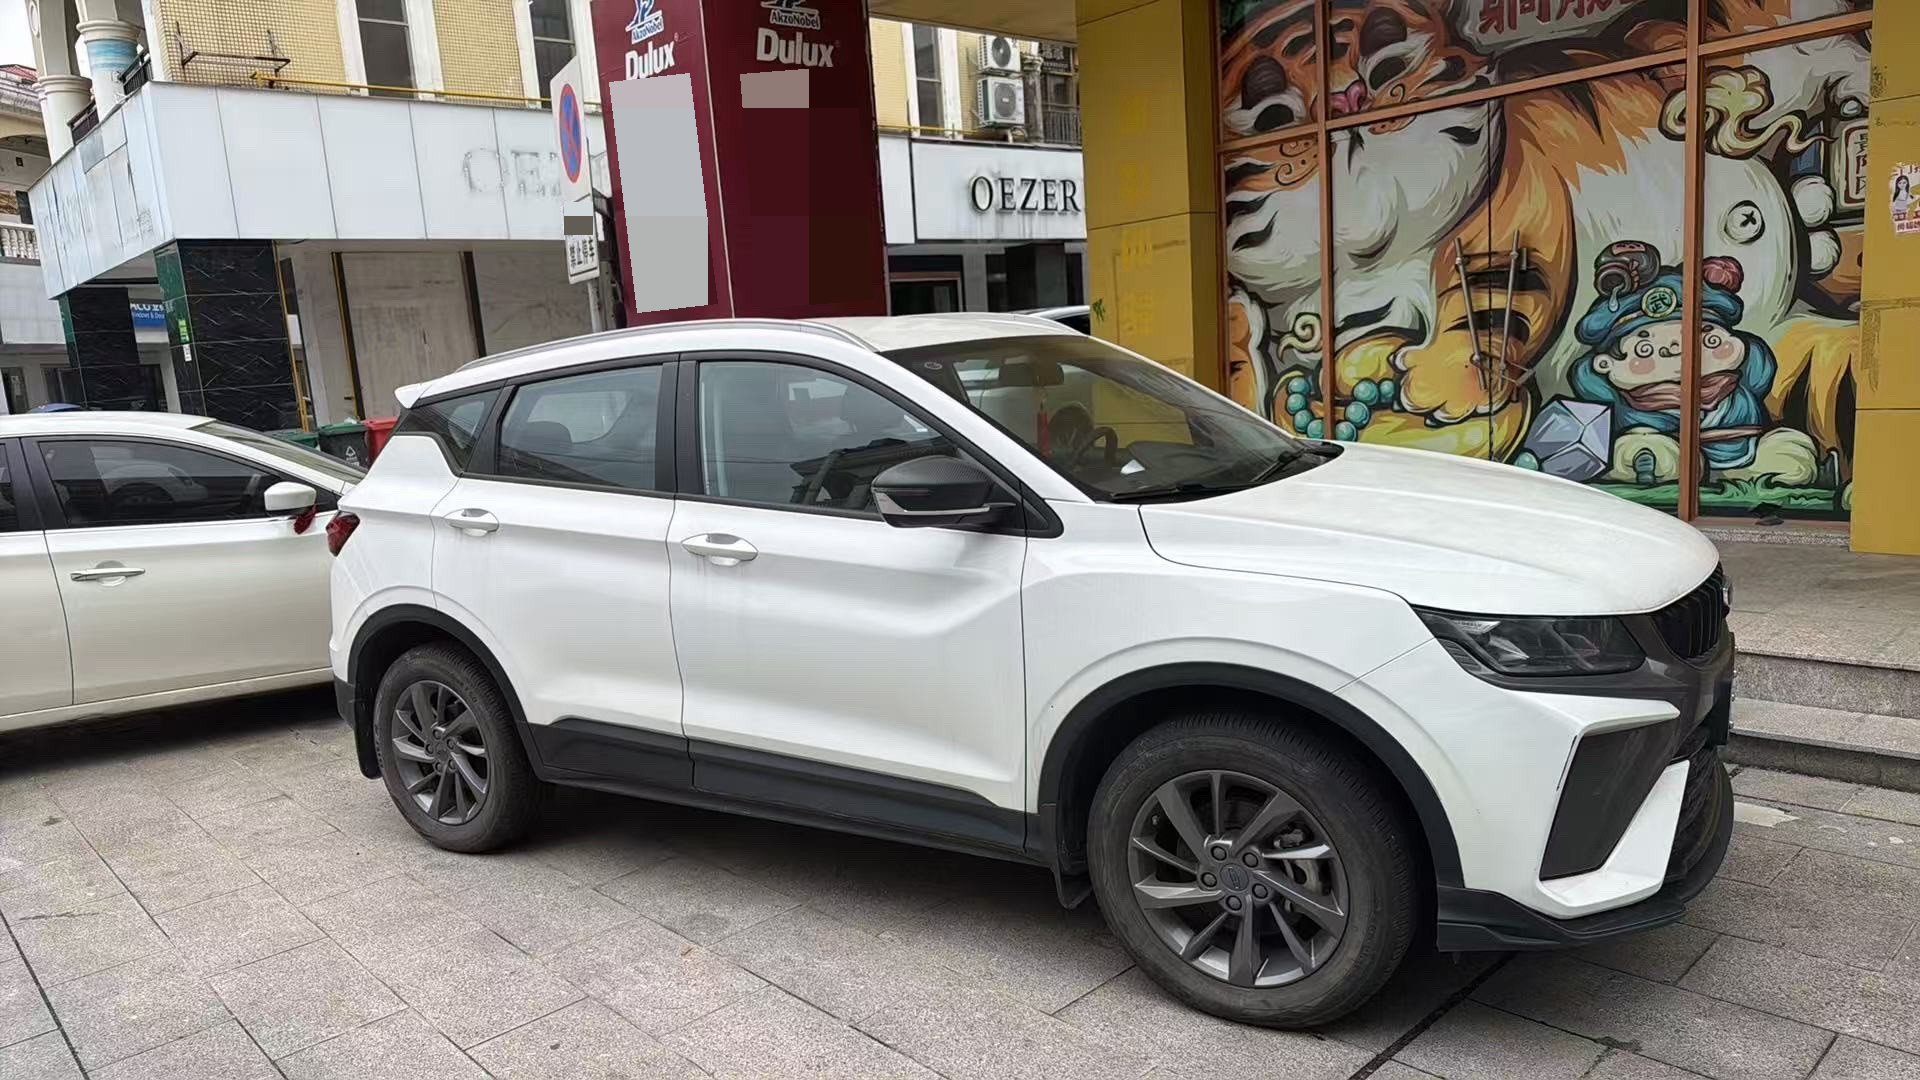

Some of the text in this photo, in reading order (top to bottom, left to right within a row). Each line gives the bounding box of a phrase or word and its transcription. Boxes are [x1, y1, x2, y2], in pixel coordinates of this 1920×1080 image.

[771, 10, 819, 28] AkzoNobel
[625, 41, 675, 80] Dulux
[757, 27, 834, 68] Dulux
[970, 176, 1081, 212] OEZER
